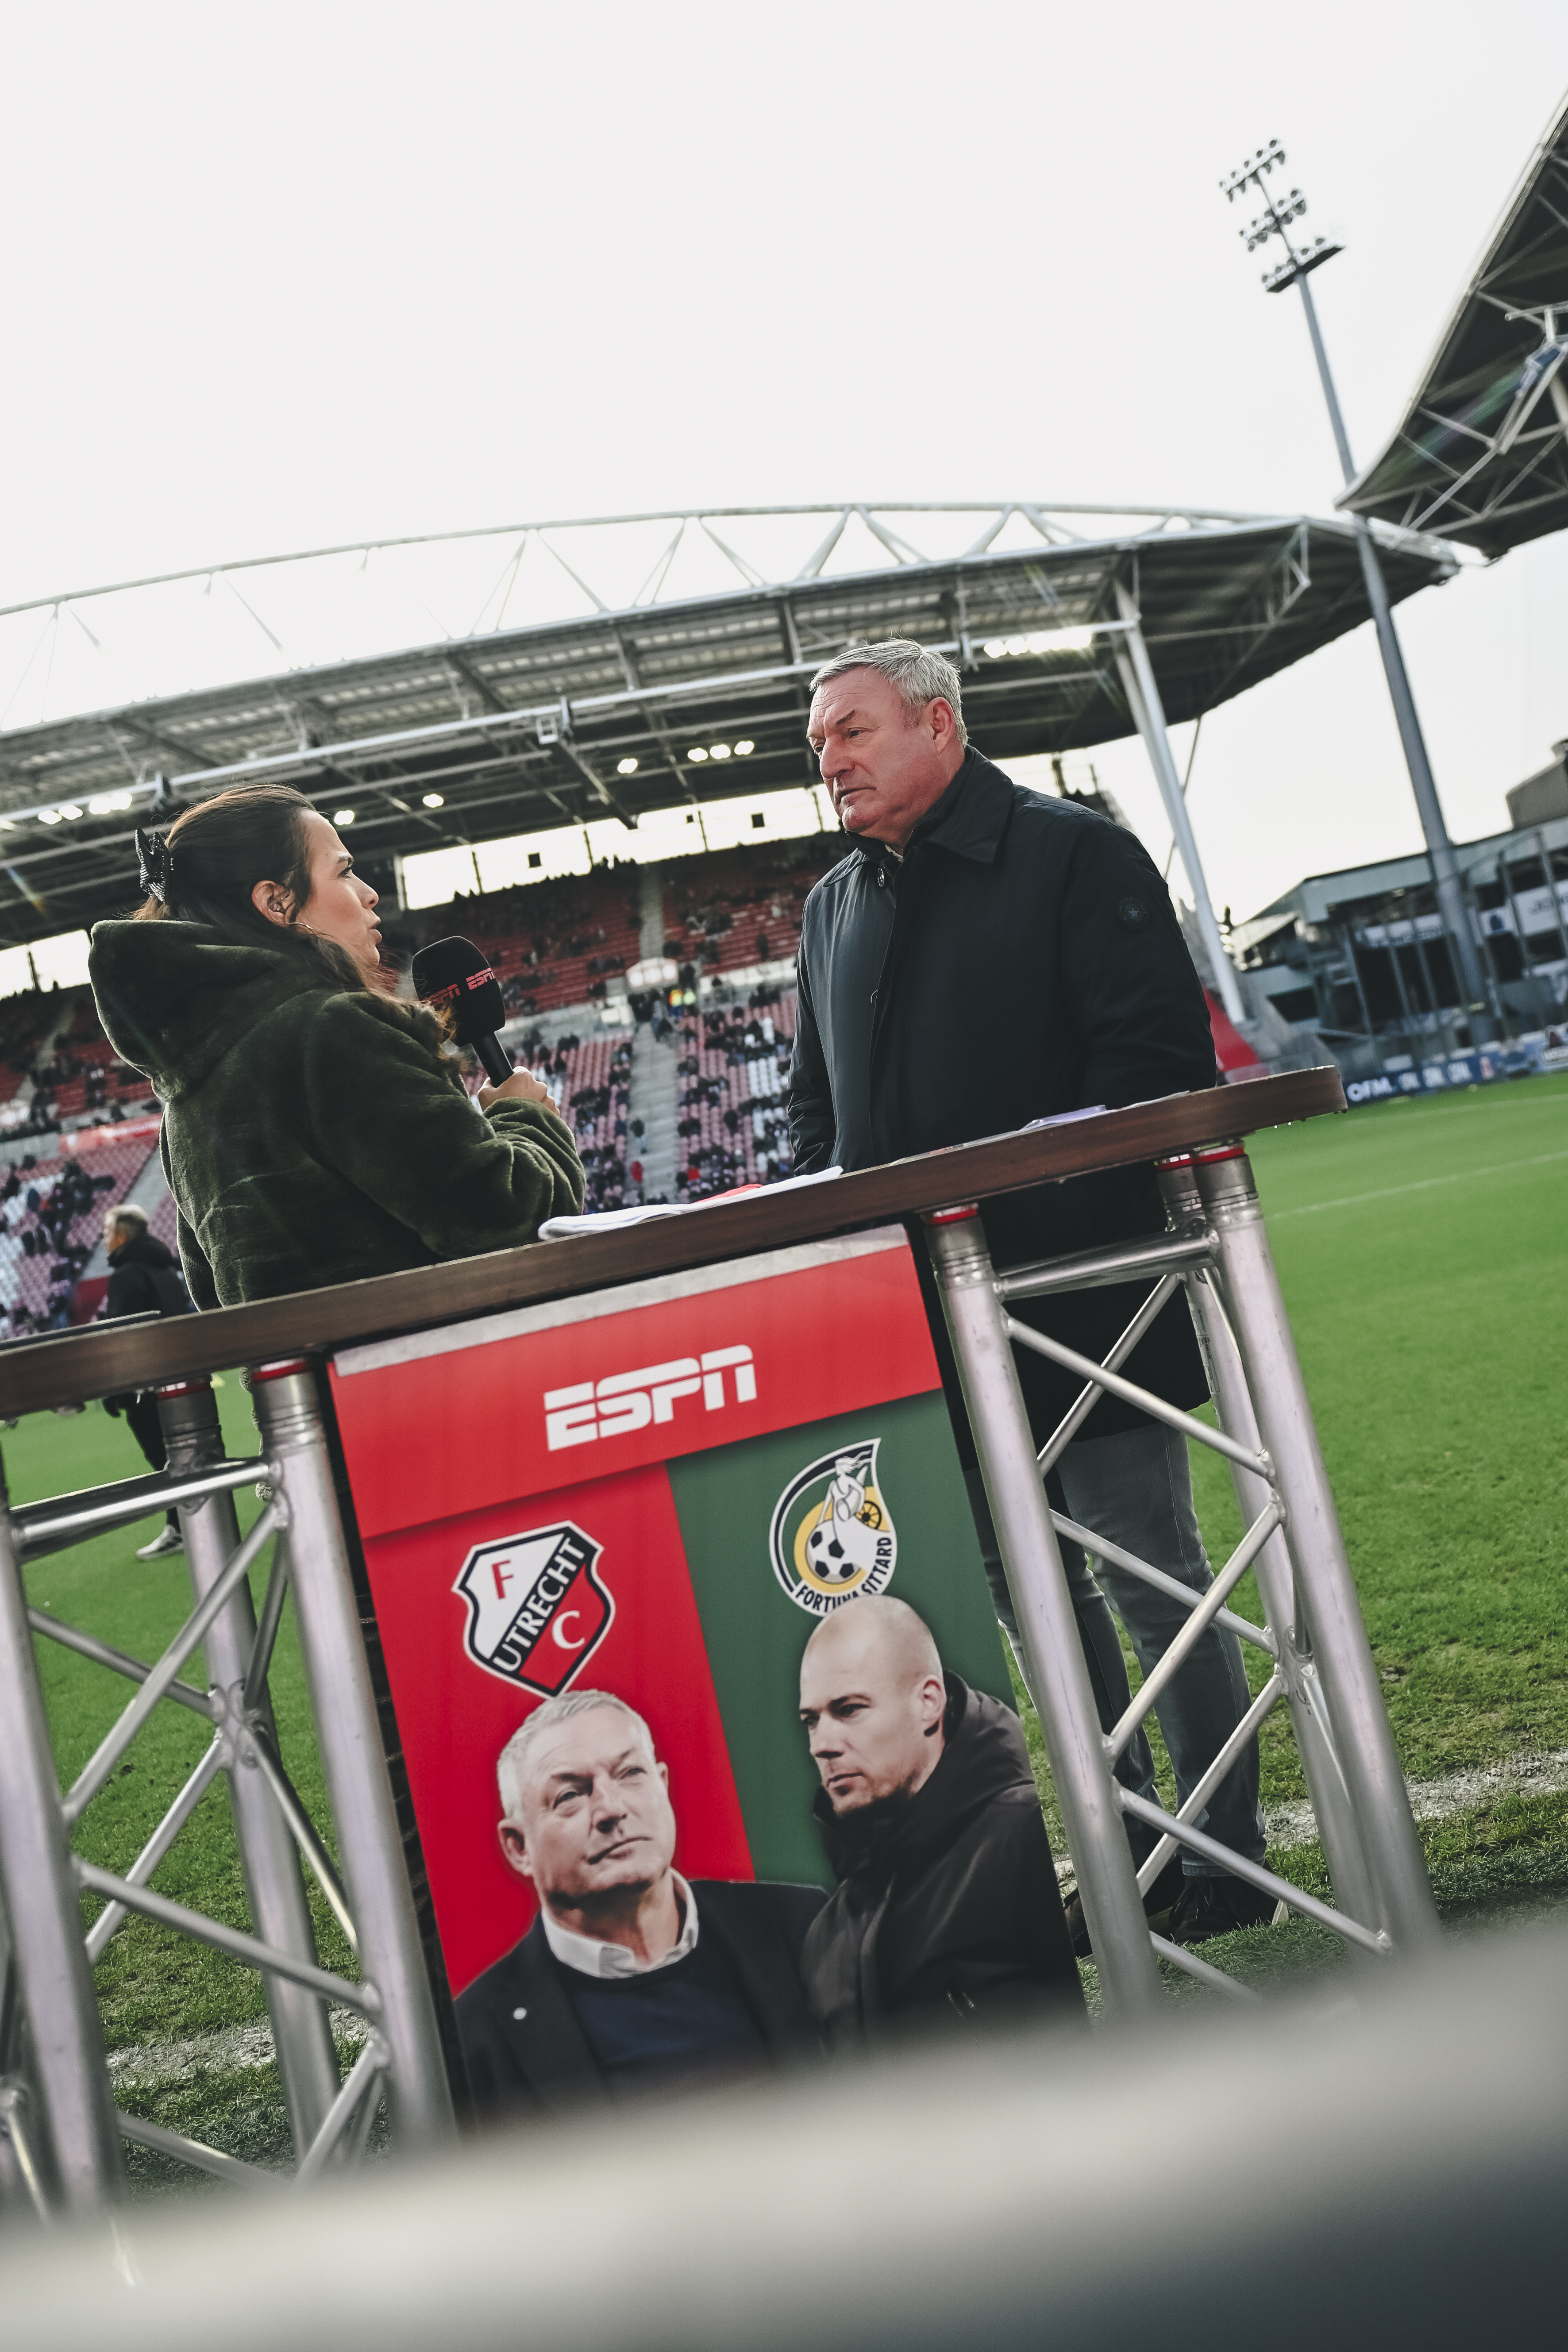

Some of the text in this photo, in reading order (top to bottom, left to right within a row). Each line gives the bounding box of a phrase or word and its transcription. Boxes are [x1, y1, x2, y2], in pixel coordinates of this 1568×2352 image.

[423, 984, 460, 1007] SPN
[543, 1343, 758, 1452] ESPN
[491, 1559, 514, 1599] F
[861, 1536, 892, 1594] SITTARD
[493, 1536, 586, 1672] UTRECHT
[552, 1610, 586, 1650] C
